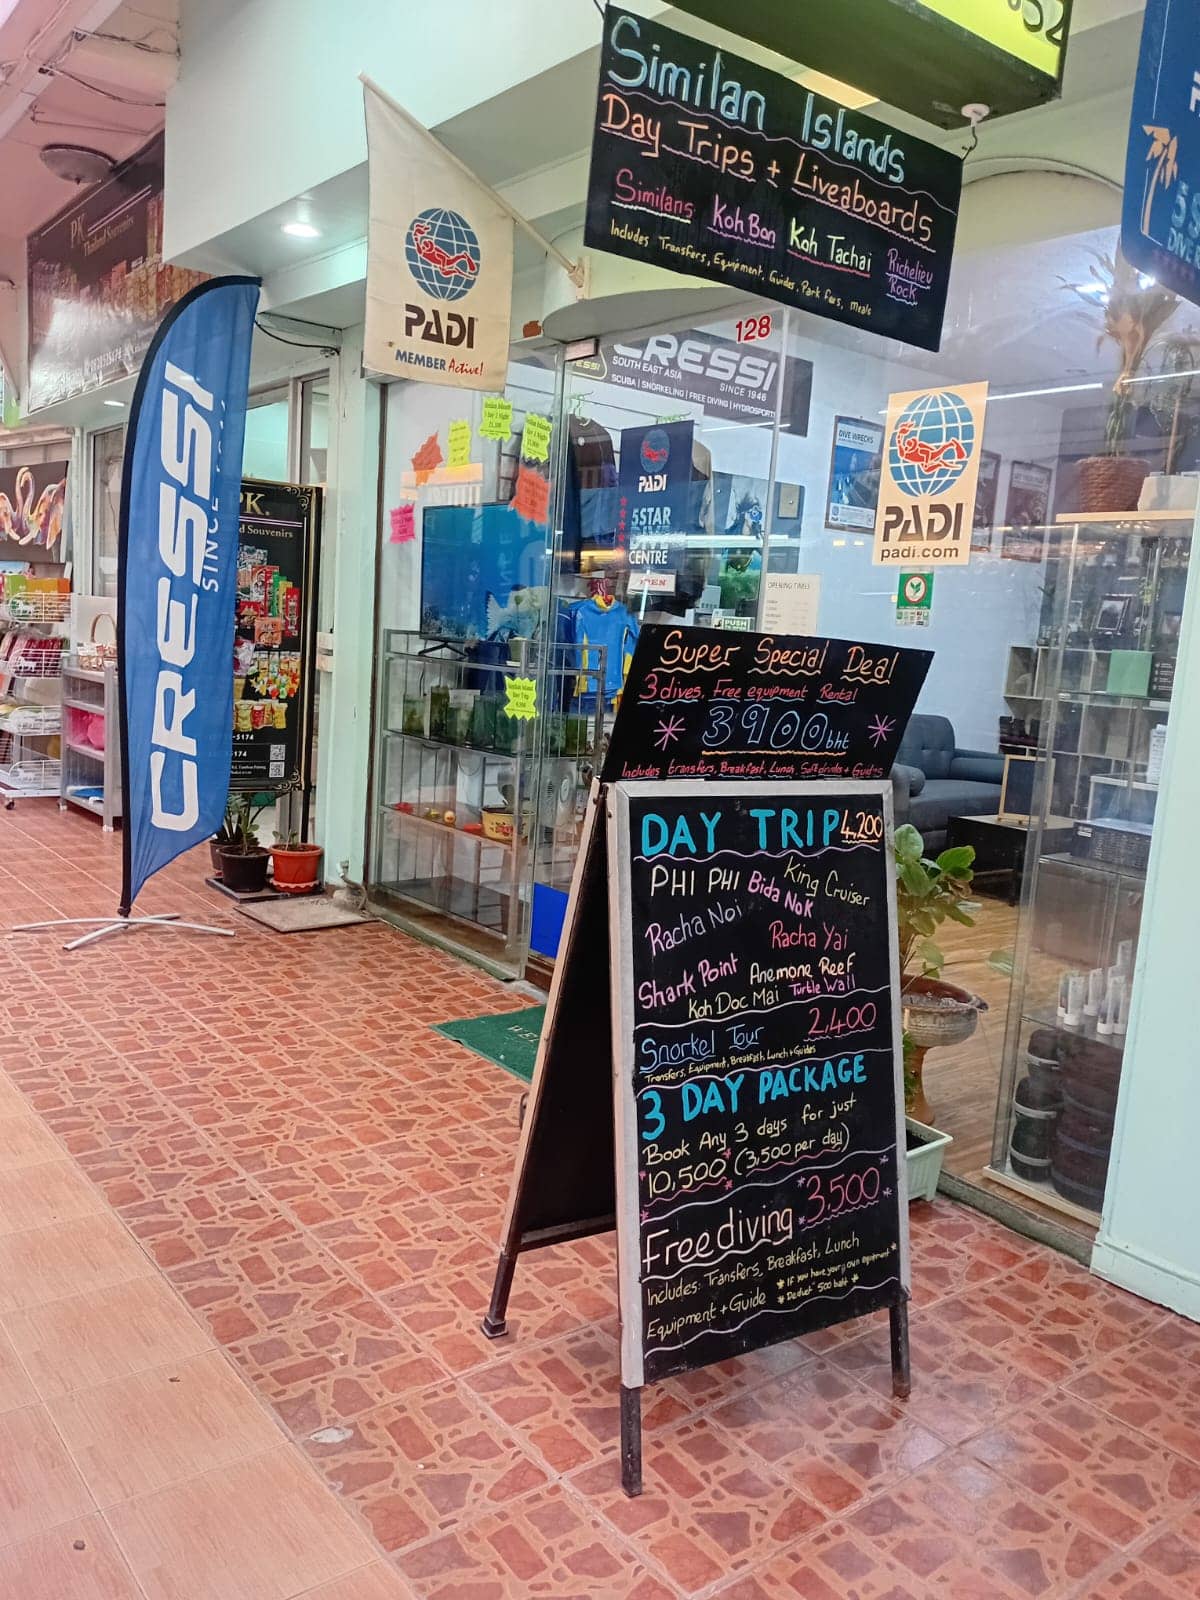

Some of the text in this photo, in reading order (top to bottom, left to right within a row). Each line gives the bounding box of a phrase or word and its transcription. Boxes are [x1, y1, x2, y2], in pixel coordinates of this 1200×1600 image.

[608, 15, 906, 184] Similan Islands
[603, 95, 936, 243] Day Trips + Liveaboards
[615, 169, 694, 220] Similans
[713, 194, 776, 244] Koh Bon
[610, 219, 649, 246] Includes
[801, 280, 821, 298] Park
[790, 218, 872, 271] Koh Tachai
[888, 248, 933, 285] Richelieu
[889, 277, 917, 300] Rock
[405, 303, 475, 349] PADI
[736, 315, 771, 342] 128
[395, 349, 484, 376] MEMBER Active!
[612, 356, 682, 381] SOUTH EAST ASIA
[611, 373, 636, 386] SCUBA
[641, 380, 685, 398] SNORKELING
[689, 391, 706, 403] FREE
[707, 396, 729, 408] DIVING
[719, 383, 767, 402] SINCE 1946
[839, 430, 851, 440] DIVE
[638, 475, 668, 493] PADI
[247, 525, 294, 538] Souvenirs
[883, 503, 963, 542] PADI
[629, 550, 668, 565] CENTRE
[881, 546, 959, 562] padi.com
[151, 360, 214, 831] CRESSI
[660, 631, 900, 679] Super Special Deal
[712, 679, 741, 698] Free
[747, 686, 808, 700] equipment
[820, 686, 858, 700] Rental
[622, 761, 660, 777] Includes
[852, 762, 883, 778] Guides
[641, 812, 722, 856] DAY
[750, 808, 840, 850] TRIP
[651, 864, 740, 897] PHI PHI
[748, 870, 780, 902] Bida
[784, 856, 870, 907] King Cruiser
[645, 900, 743, 957] Racha Noi
[769, 920, 849, 951] Racha Yai
[638, 952, 739, 1010] Shark Point
[750, 952, 856, 985] Anemone Reef
[688, 985, 780, 1019] Koh Doc Mai
[789, 976, 856, 997] Turtle Wall
[808, 1002, 877, 1037] 2,400
[640, 1024, 764, 1073] Snorkel Tour
[767, 1047, 789, 1060] Lunch
[794, 1044, 816, 1056] Guides
[642, 1054, 867, 1141] 3 DAY PACKAGE
[642, 1092, 856, 1167] Book Any 3 days for just
[648, 1122, 850, 1198] 10,500 (3,500 per day)
[806, 1166, 880, 1223] 3,500
[825, 1232, 860, 1255] Lunch
[811, 1268, 826, 1278] have
[827, 1265, 840, 1277] your
[846, 1259, 860, 1269] own
[817, 1281, 832, 1293] 500
[647, 1288, 767, 1341] Equipment + Guide
